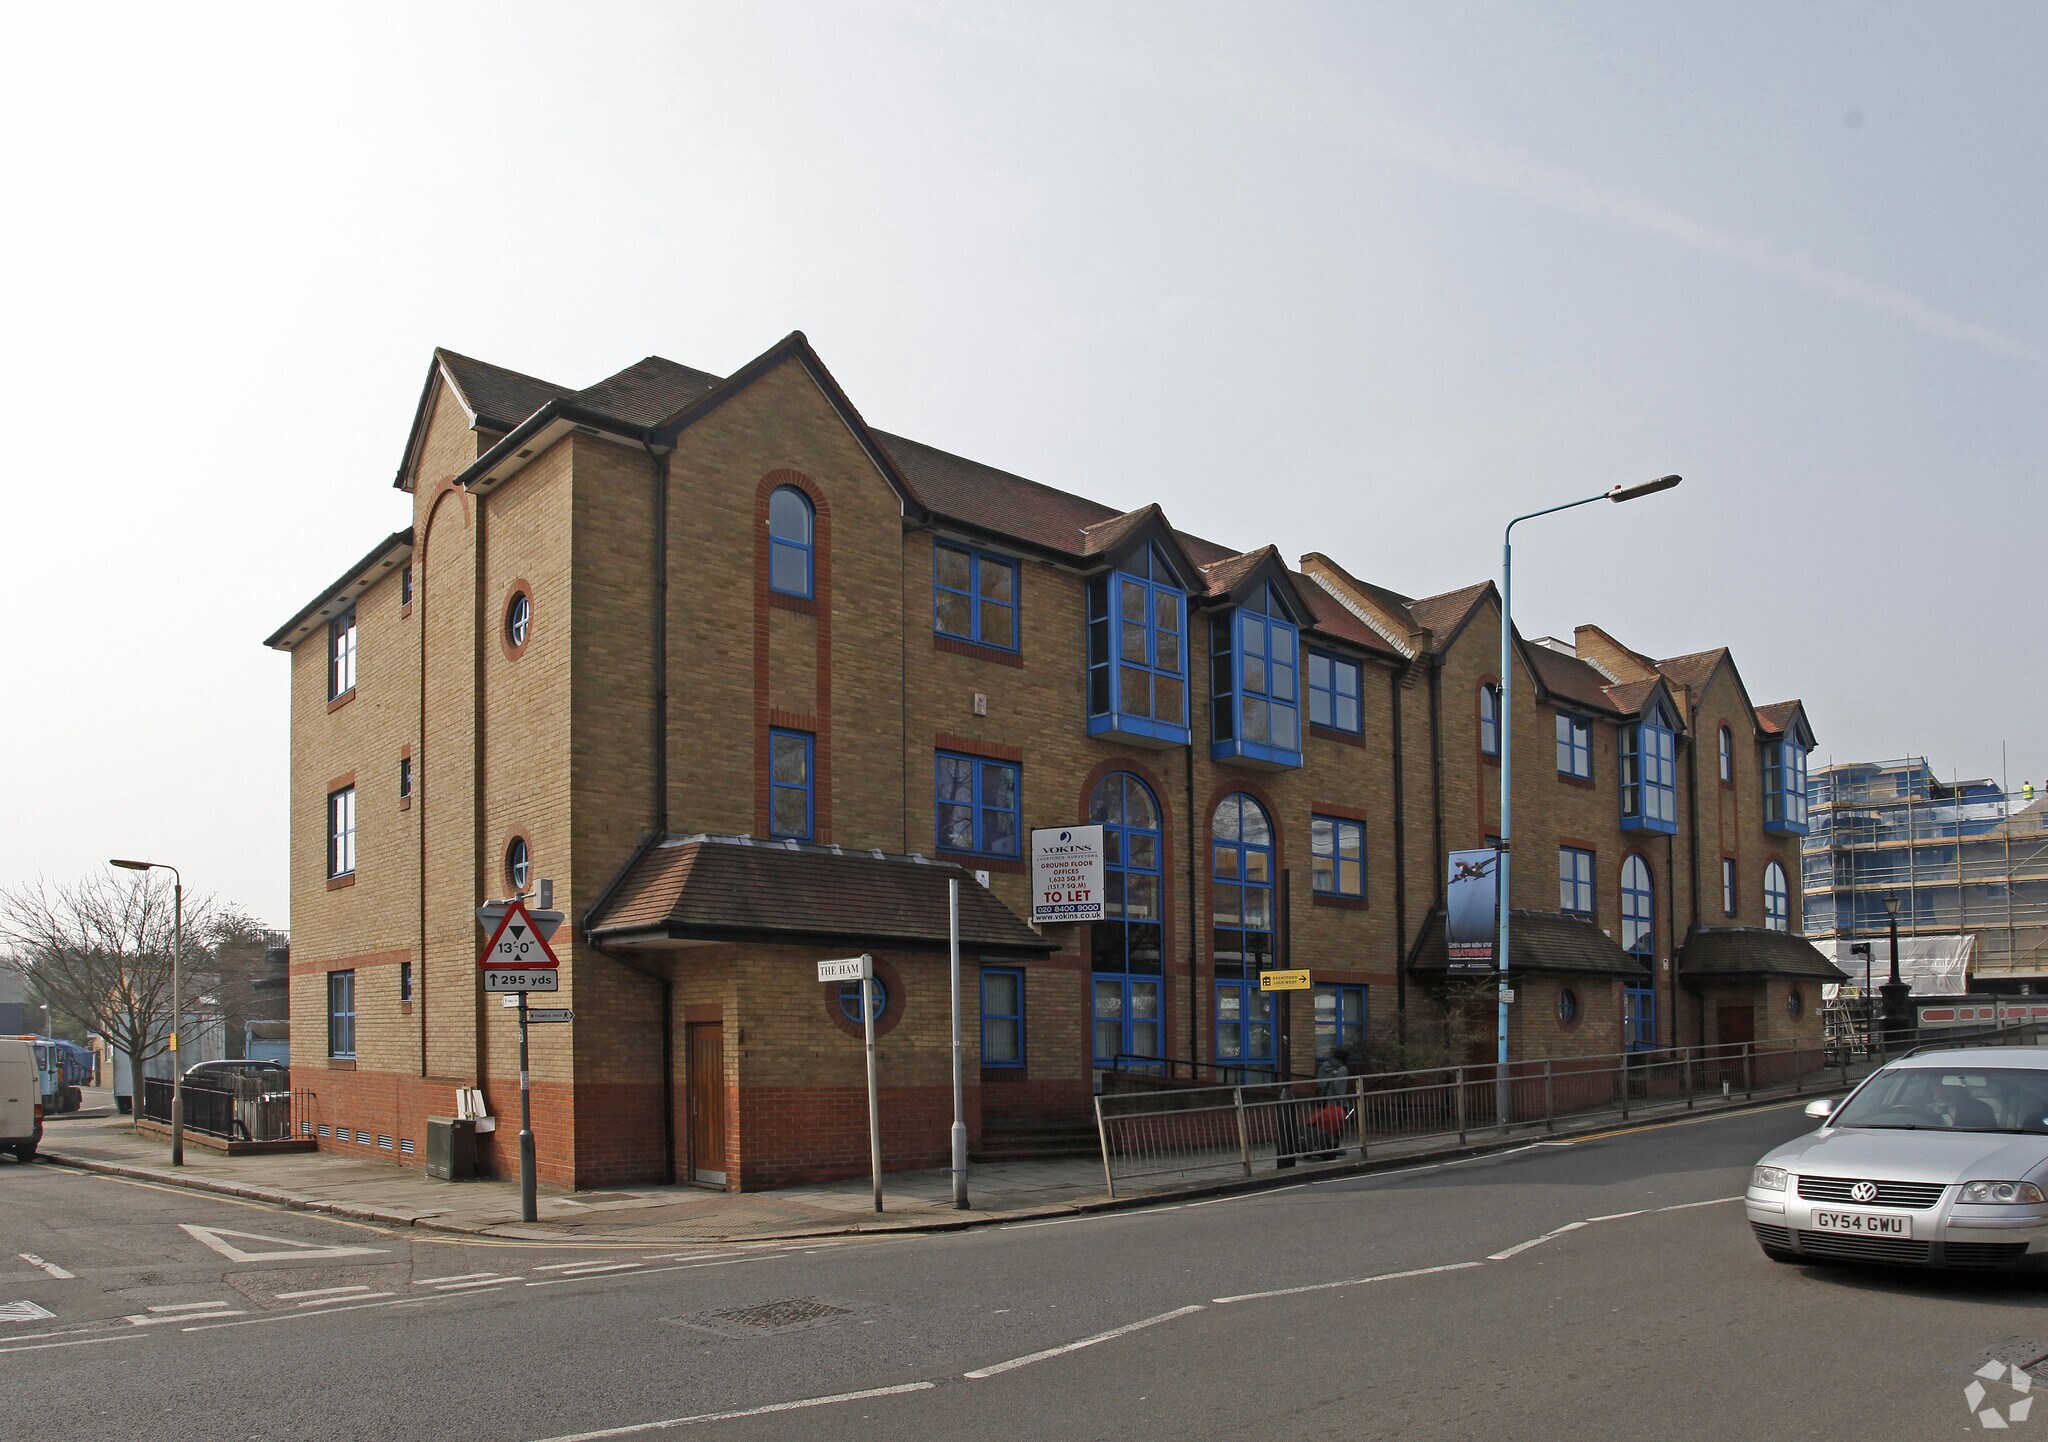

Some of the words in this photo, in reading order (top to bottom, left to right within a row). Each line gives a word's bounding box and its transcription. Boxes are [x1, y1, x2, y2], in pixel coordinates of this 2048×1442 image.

[1042, 844, 1092, 854] VOKINS
[1044, 892, 1062, 903] TO
[1068, 890, 1091, 902] LET
[1036, 912, 1101, 920] www.vokins.co.uk
[820, 966, 837, 976] THE
[839, 964, 859, 974] HAM
[501, 975, 526, 985] 295
[531, 975, 552, 986] yds
[1818, 1212, 1862, 1230] GY54
[1867, 1216, 1902, 1234] GWU
